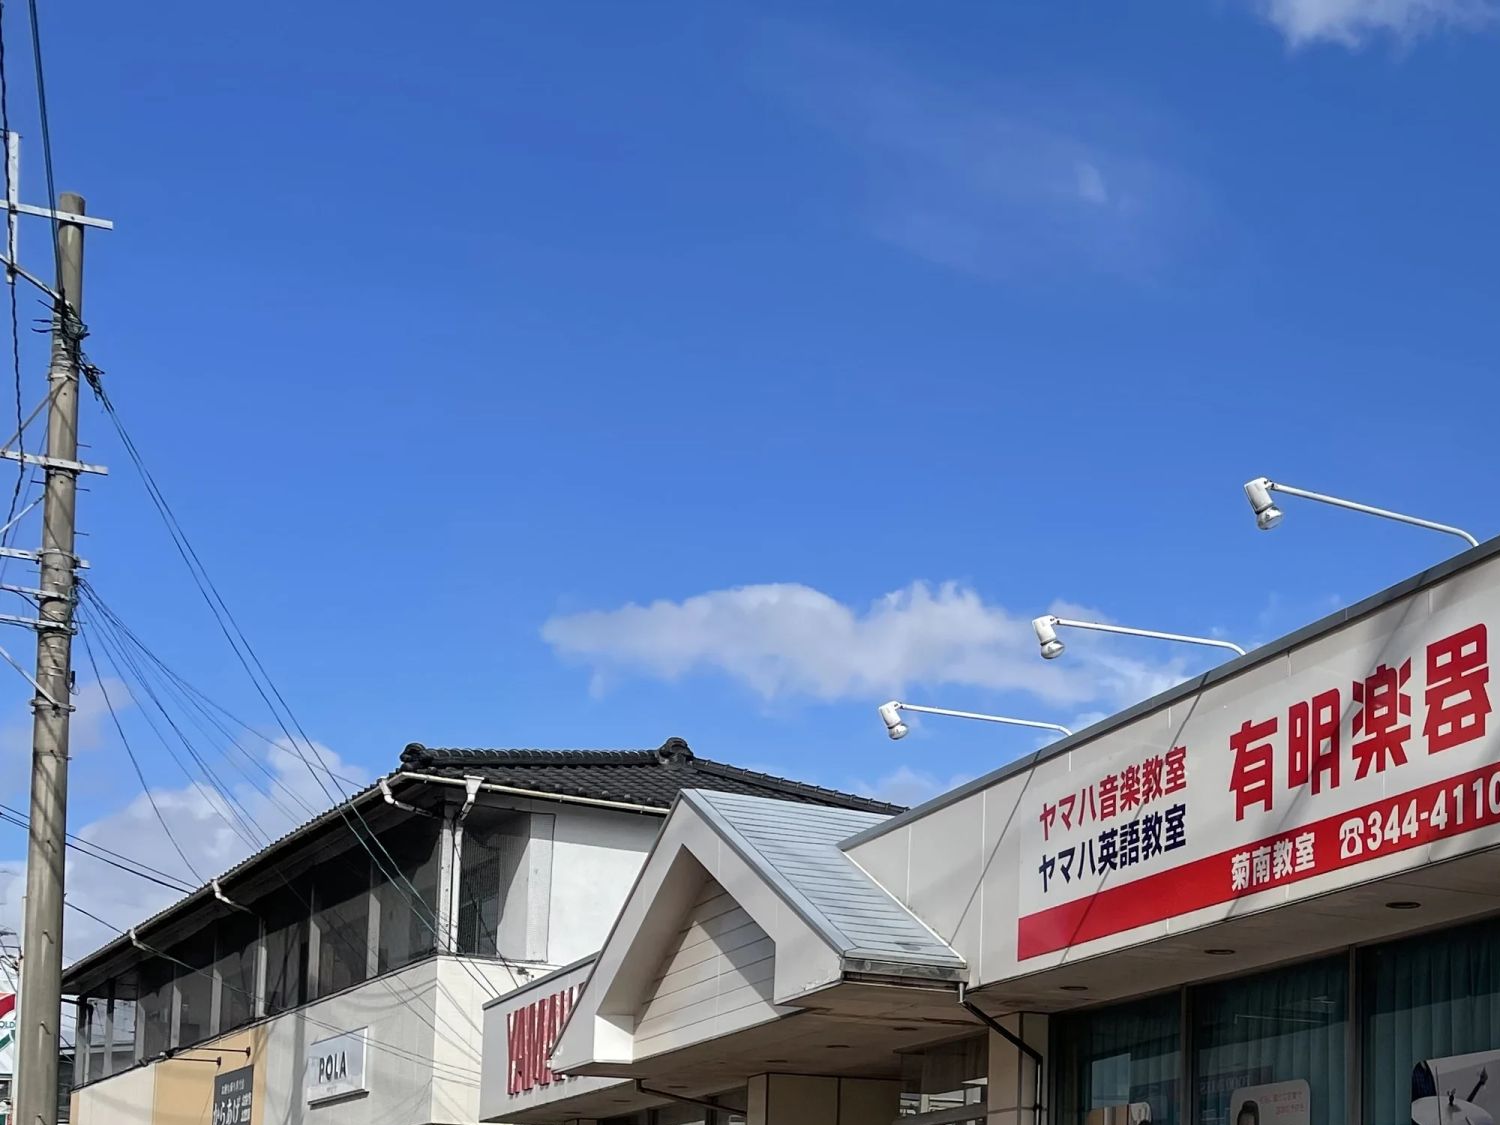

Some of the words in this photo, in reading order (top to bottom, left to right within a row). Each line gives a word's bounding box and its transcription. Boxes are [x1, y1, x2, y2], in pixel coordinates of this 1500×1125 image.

[1228, 623, 1493, 822] 有明楽器
[1039, 745, 1187, 842] ヤマハ音楽教室
[1038, 803, 1187, 893] ヤマハ英語教室
[1231, 832, 1316, 892] 菊南教室
[319, 1051, 347, 1084] POLA
